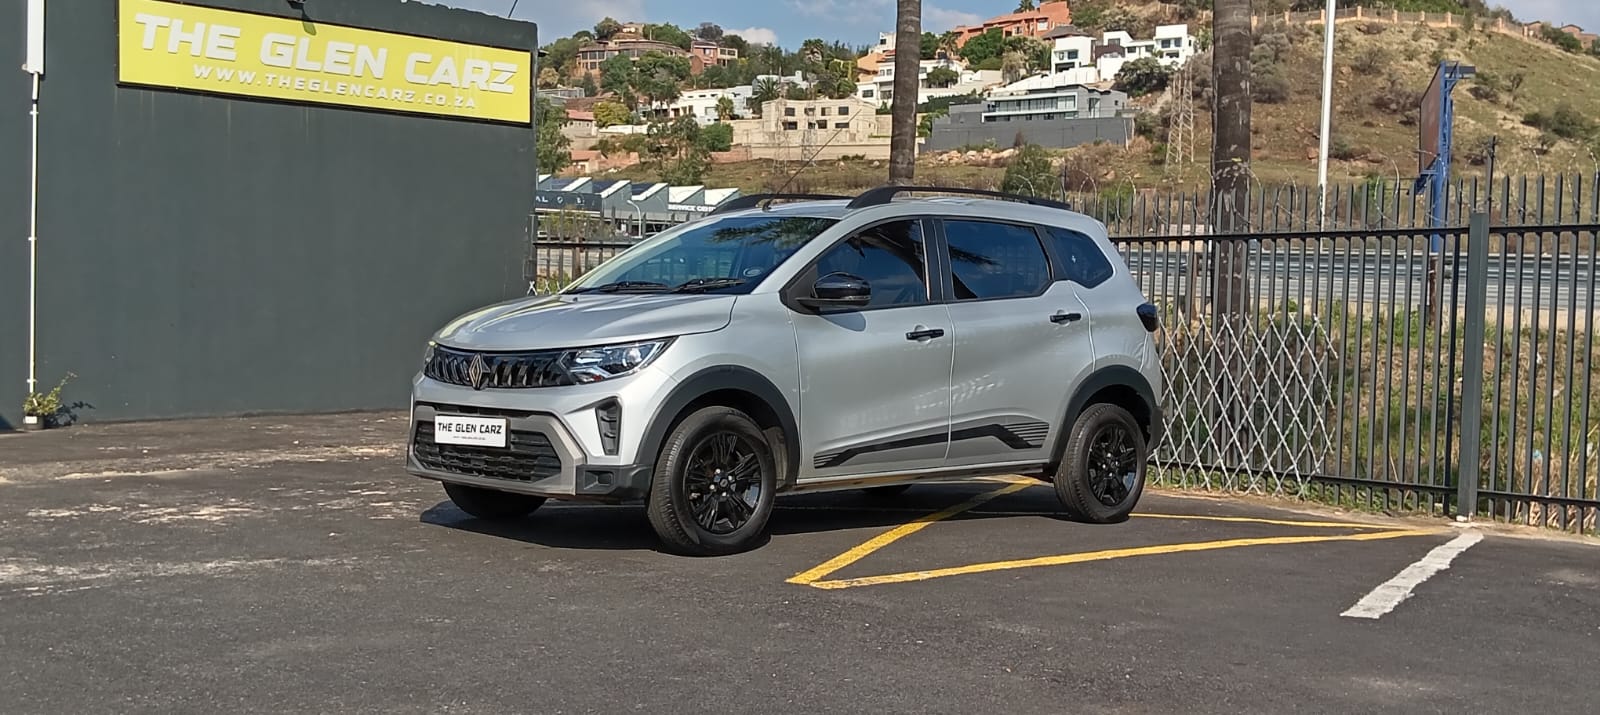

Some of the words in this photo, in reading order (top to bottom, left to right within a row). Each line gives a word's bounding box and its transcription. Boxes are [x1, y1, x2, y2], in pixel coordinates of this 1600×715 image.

[135, 12, 241, 61] THE
[260, 32, 388, 80] GLEN
[404, 52, 518, 94] CARZ
[193, 63, 476, 109] WWW.THEGLENCARZ.CO.ZA
[437, 422, 453, 432] THE
[455, 423, 477, 433] GLEN
[480, 424, 502, 434] CARZ
